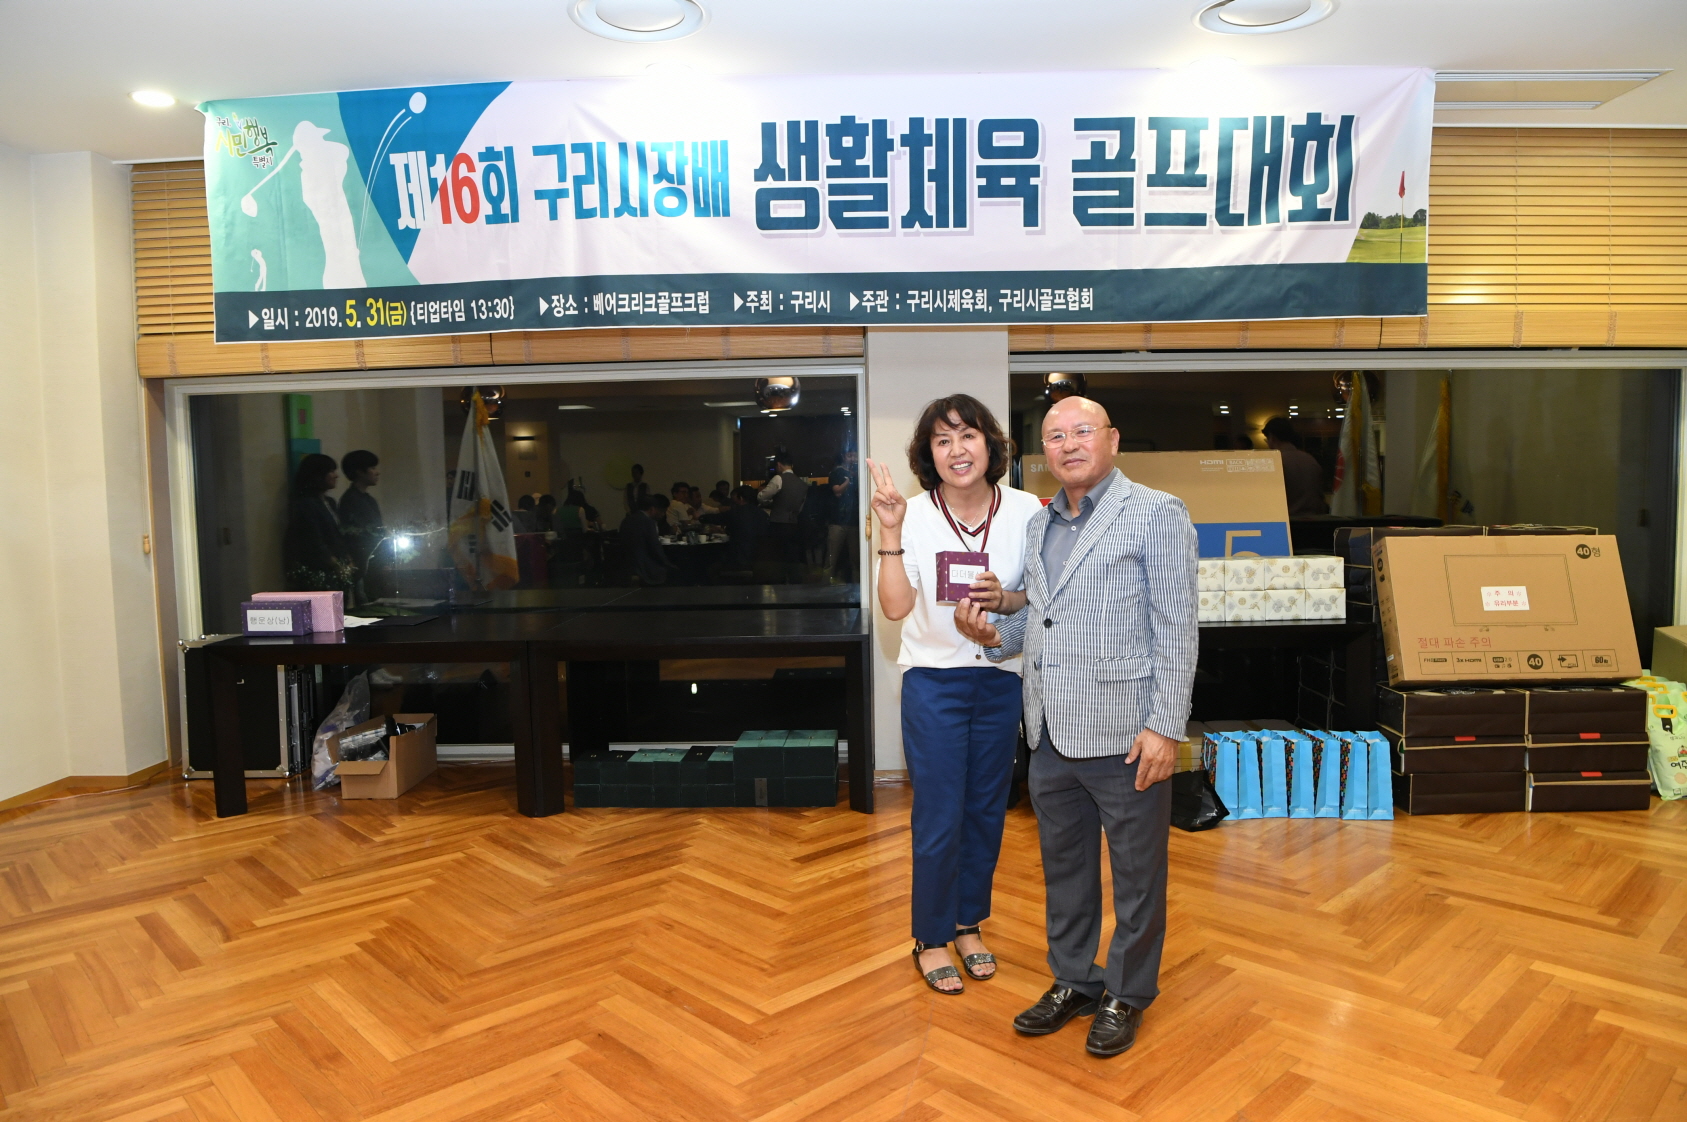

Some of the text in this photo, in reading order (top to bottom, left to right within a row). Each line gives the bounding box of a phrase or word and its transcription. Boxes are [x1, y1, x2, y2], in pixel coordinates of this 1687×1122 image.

[215, 117, 278, 158] 시민행복
[252, 156, 274, 169] 특별시
[389, 110, 1359, 232] 제16회 구리시장배 생활체육 골프대회
[261, 307, 289, 331] 일시
[304, 306, 343, 329] 2019.
[345, 299, 362, 329] 5.
[366, 297, 408, 328] 31(금)
[410, 299, 466, 326] {티업타임
[470, 295, 515, 321] 13:30}
[551, 293, 579, 318] 장소
[592, 290, 710, 316] 베어크리크골프크럽
[745, 290, 773, 314] 주최
[790, 289, 831, 314] 구리시
[861, 289, 889, 313] 주관
[906, 287, 993, 314] 구리시체육회,
[998, 287, 1094, 312] 구리시골프협회
[1417, 636, 1492, 650] 절대 파손 주의
[1528, 657, 1542, 666] 40
